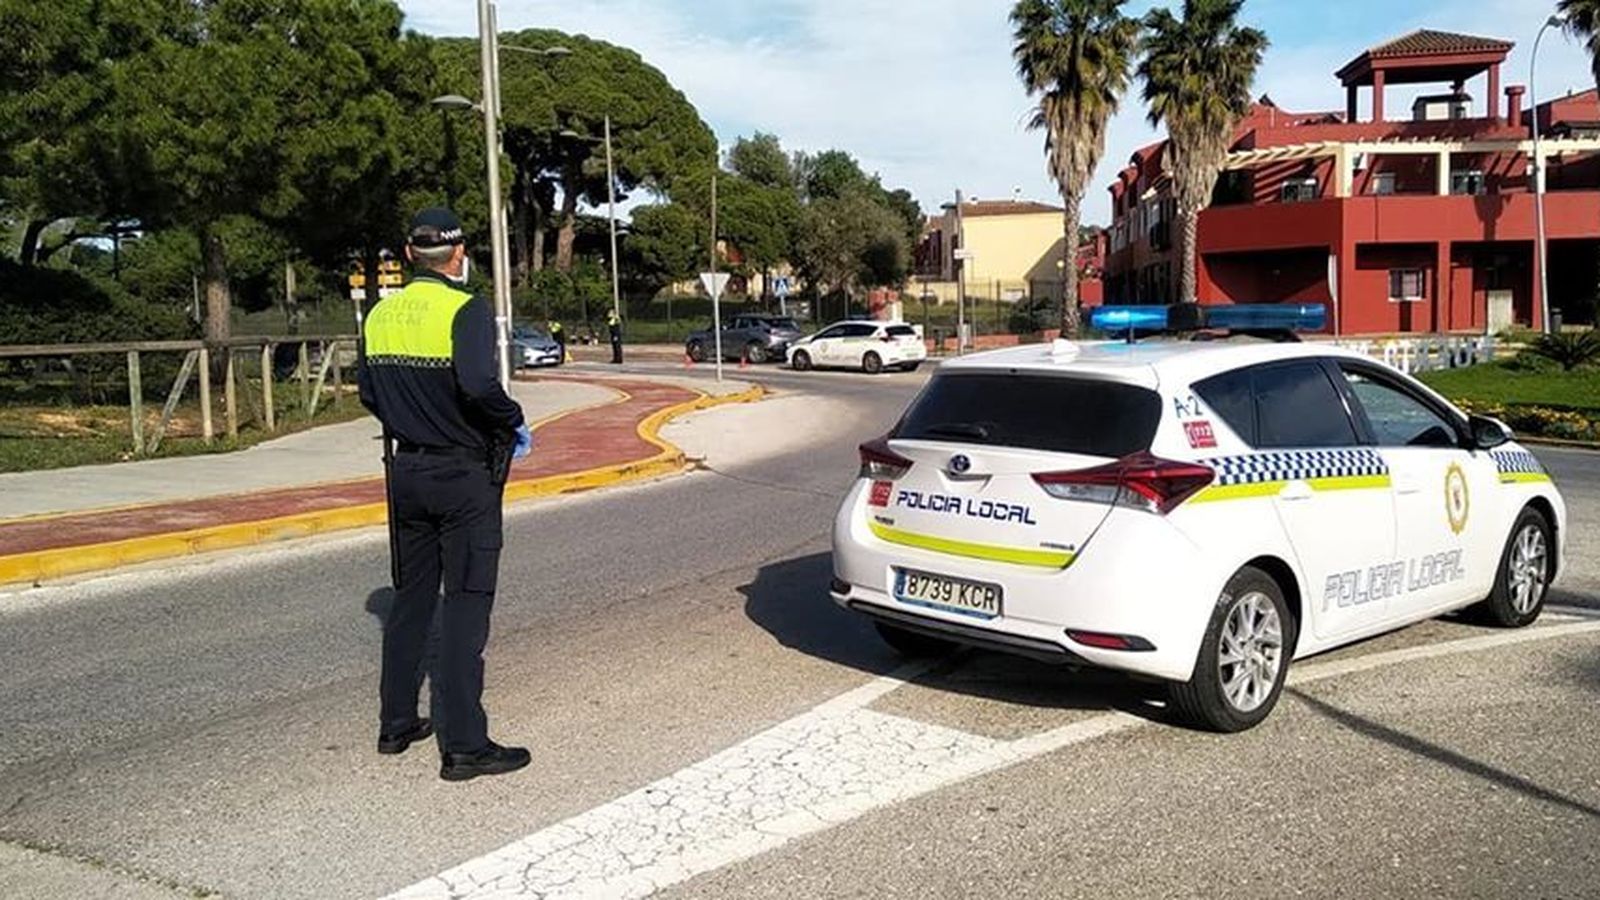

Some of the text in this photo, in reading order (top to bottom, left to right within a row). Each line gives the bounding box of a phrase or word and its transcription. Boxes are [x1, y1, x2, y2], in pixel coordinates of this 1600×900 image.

[1173, 395, 1203, 418] A-2
[897, 491, 961, 514] POLICIA
[966, 498, 1036, 525] LOCAL
[908, 575, 996, 611] 8739 KCR
[1322, 549, 1465, 613] POLICIA LOCAL
